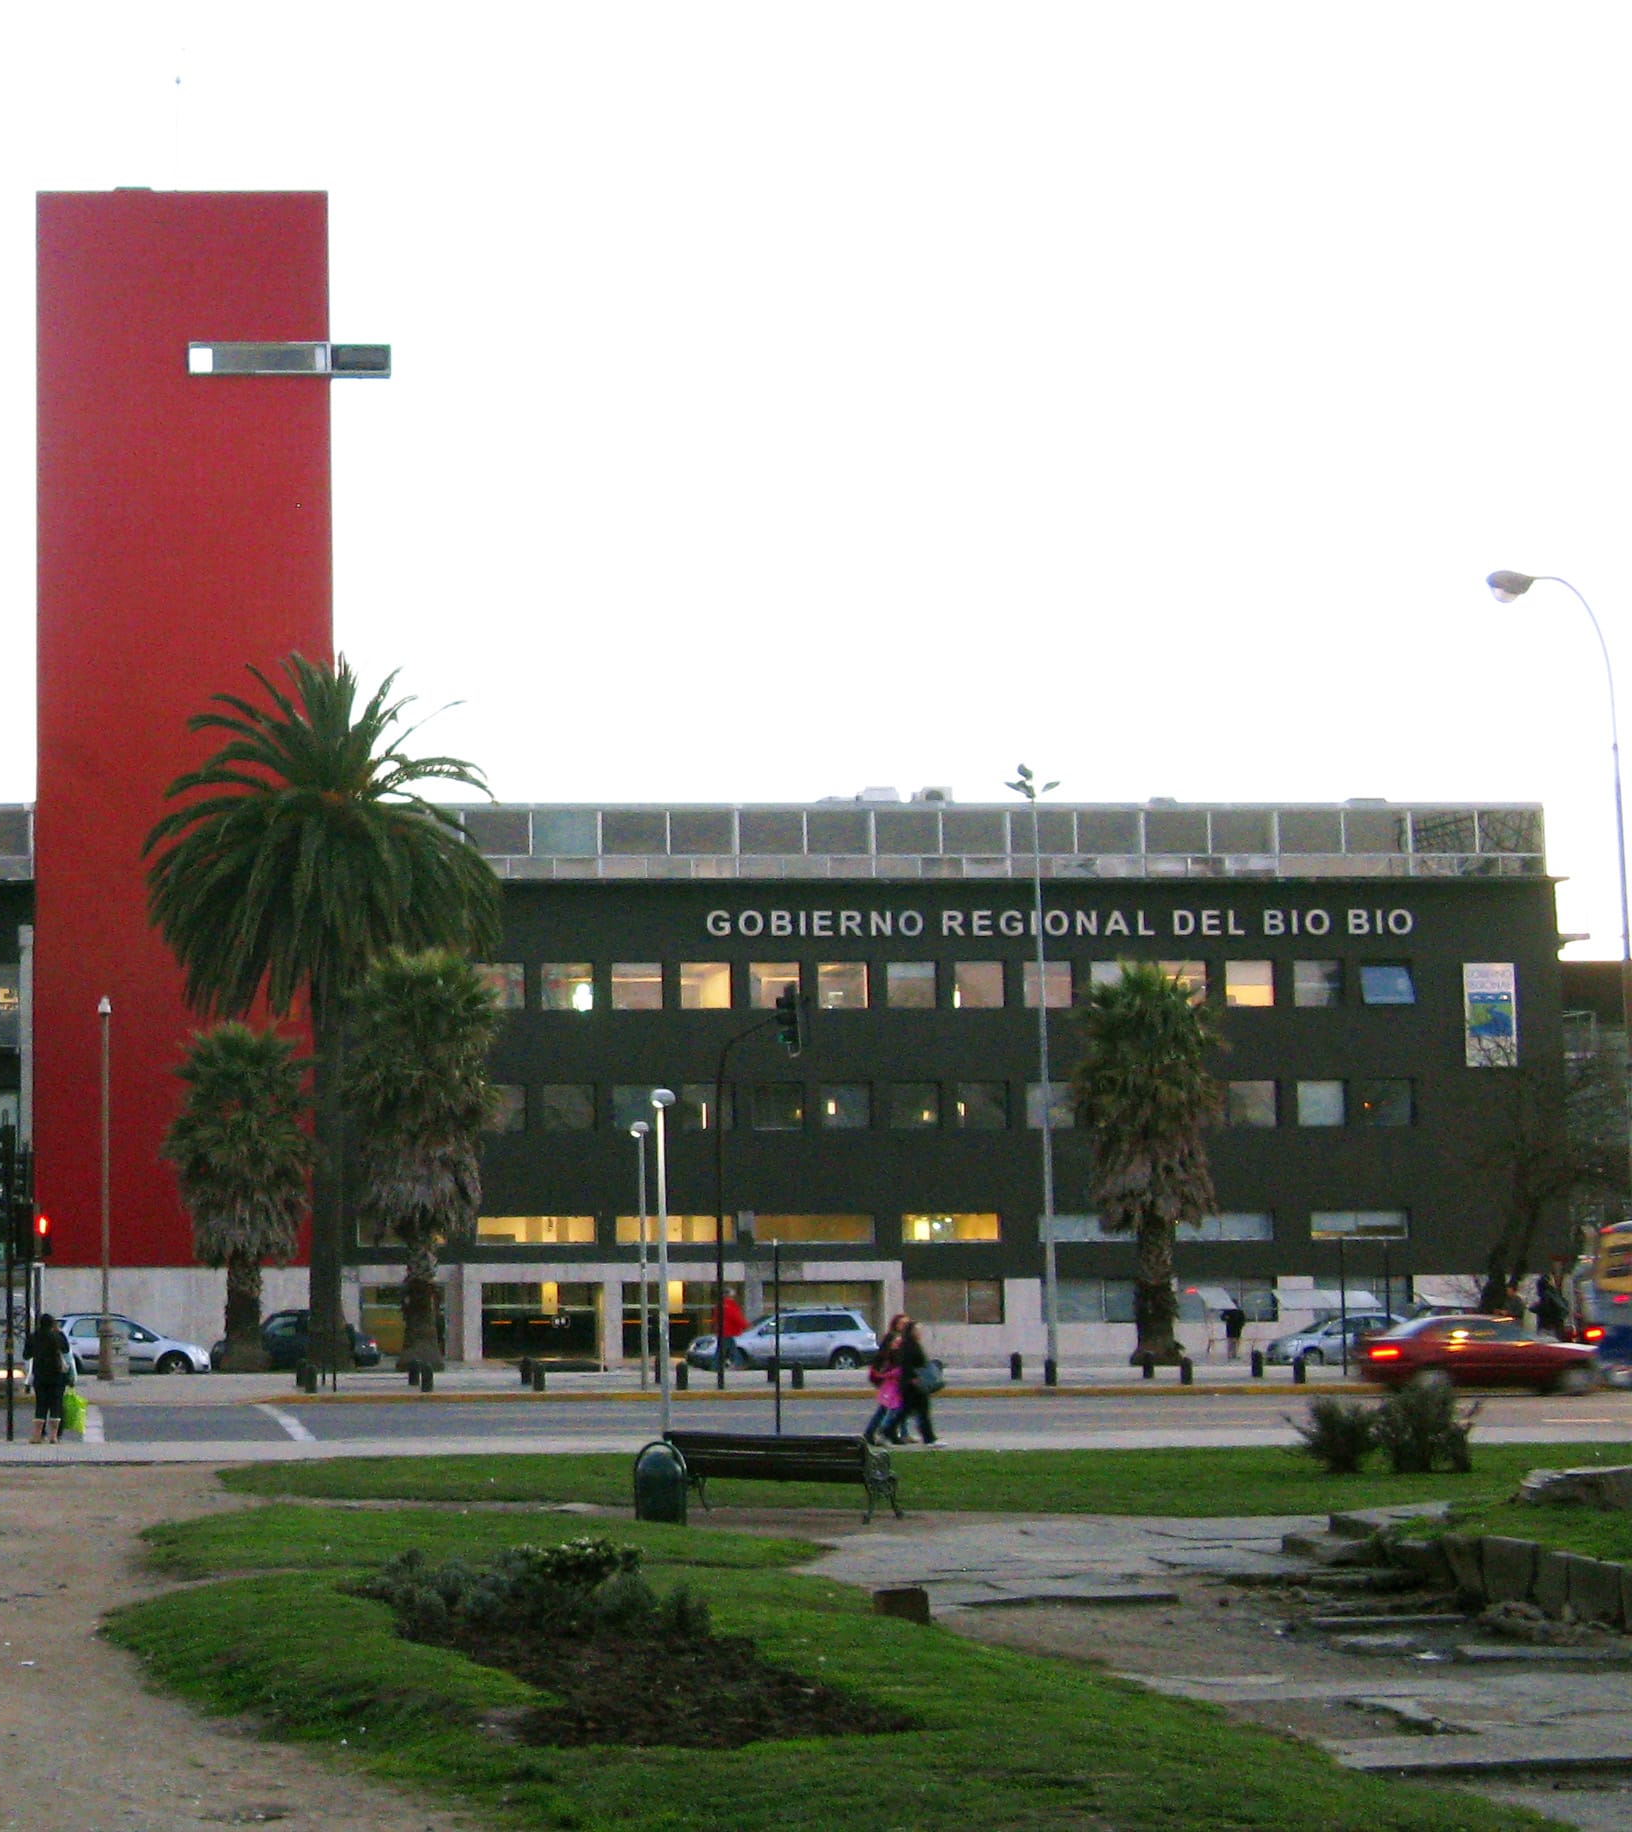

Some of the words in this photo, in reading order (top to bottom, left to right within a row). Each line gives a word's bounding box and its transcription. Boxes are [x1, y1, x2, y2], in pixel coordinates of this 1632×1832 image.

[706, 909, 924, 937] GOBIERNO
[942, 909, 1156, 937] REGIONAL
[1172, 909, 1246, 937] DEL
[1263, 909, 1330, 936] BIO
[1347, 908, 1414, 935] BIO
